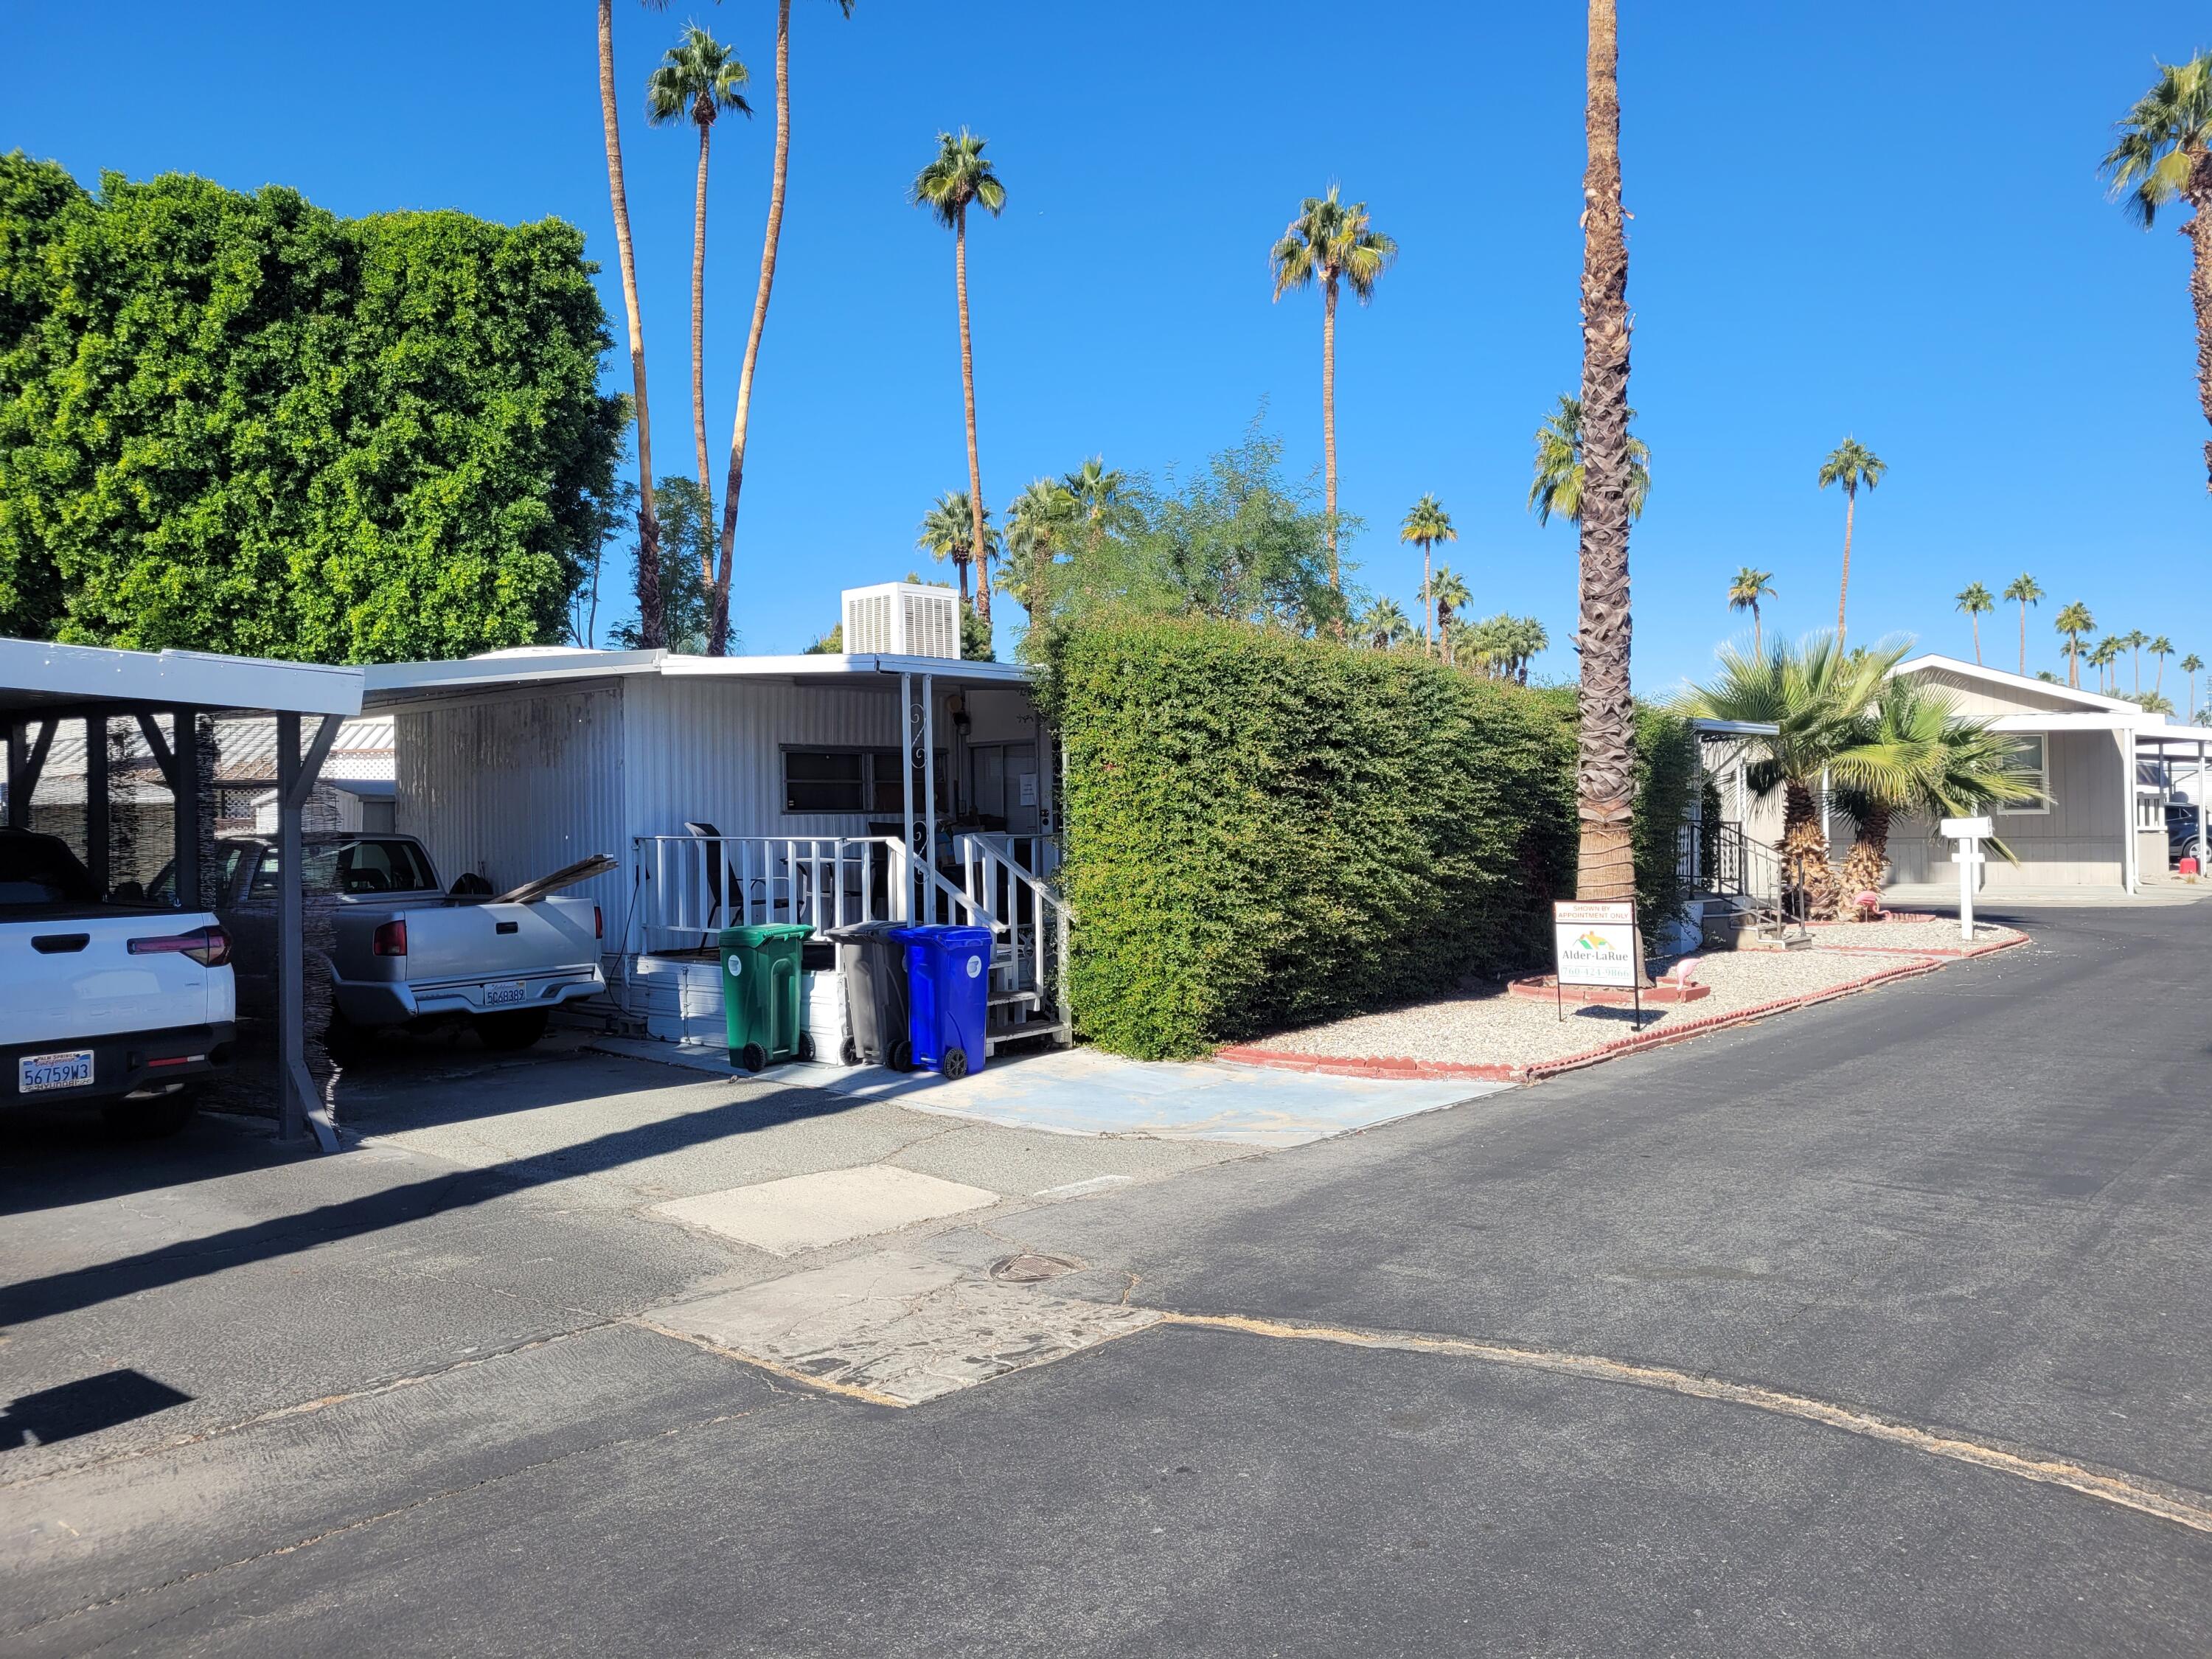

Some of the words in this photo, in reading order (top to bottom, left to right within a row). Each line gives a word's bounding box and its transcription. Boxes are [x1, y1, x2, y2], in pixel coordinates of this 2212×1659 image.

[1562, 950, 1629, 961] Alder-LaRue
[24, 1064, 88, 1086] 56759W3
[37, 1080, 77, 1091] HYUNDAI
